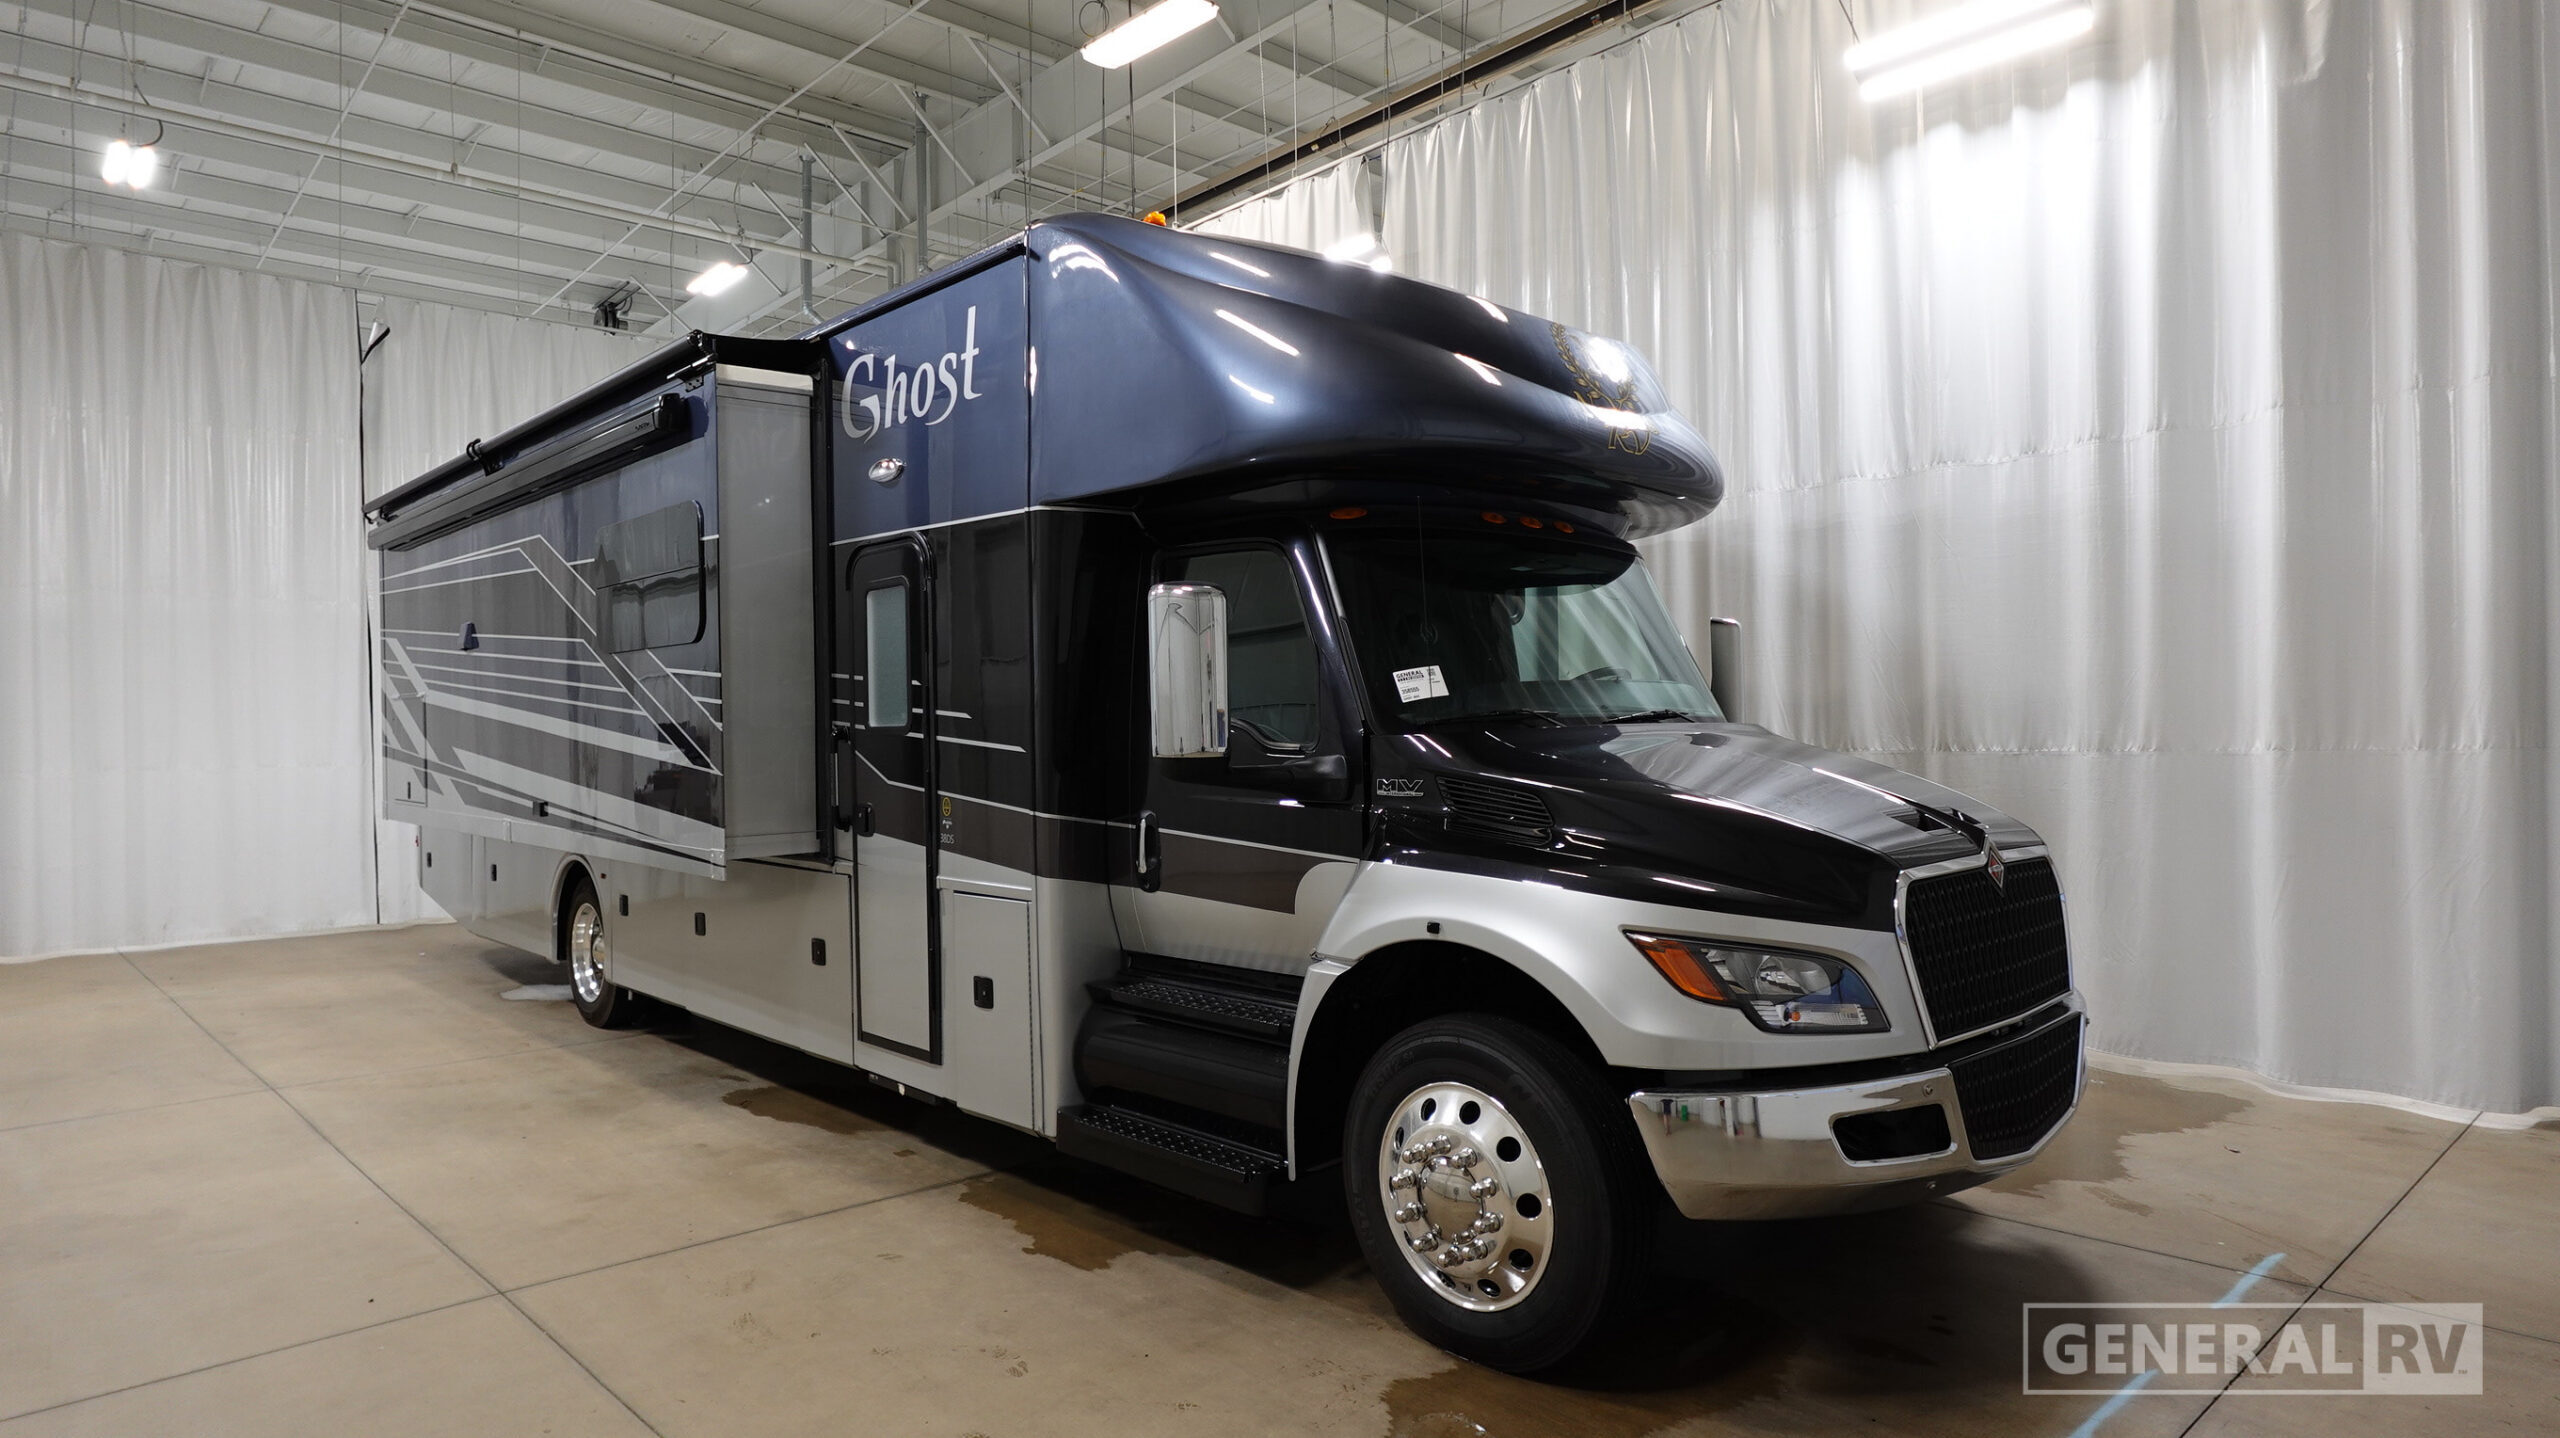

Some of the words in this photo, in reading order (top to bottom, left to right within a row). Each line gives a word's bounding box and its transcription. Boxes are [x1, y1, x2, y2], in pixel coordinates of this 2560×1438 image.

[841, 305, 983, 444] Ghost
[1396, 670, 1424, 679] GENERAL
[1376, 778, 1424, 796] MV
